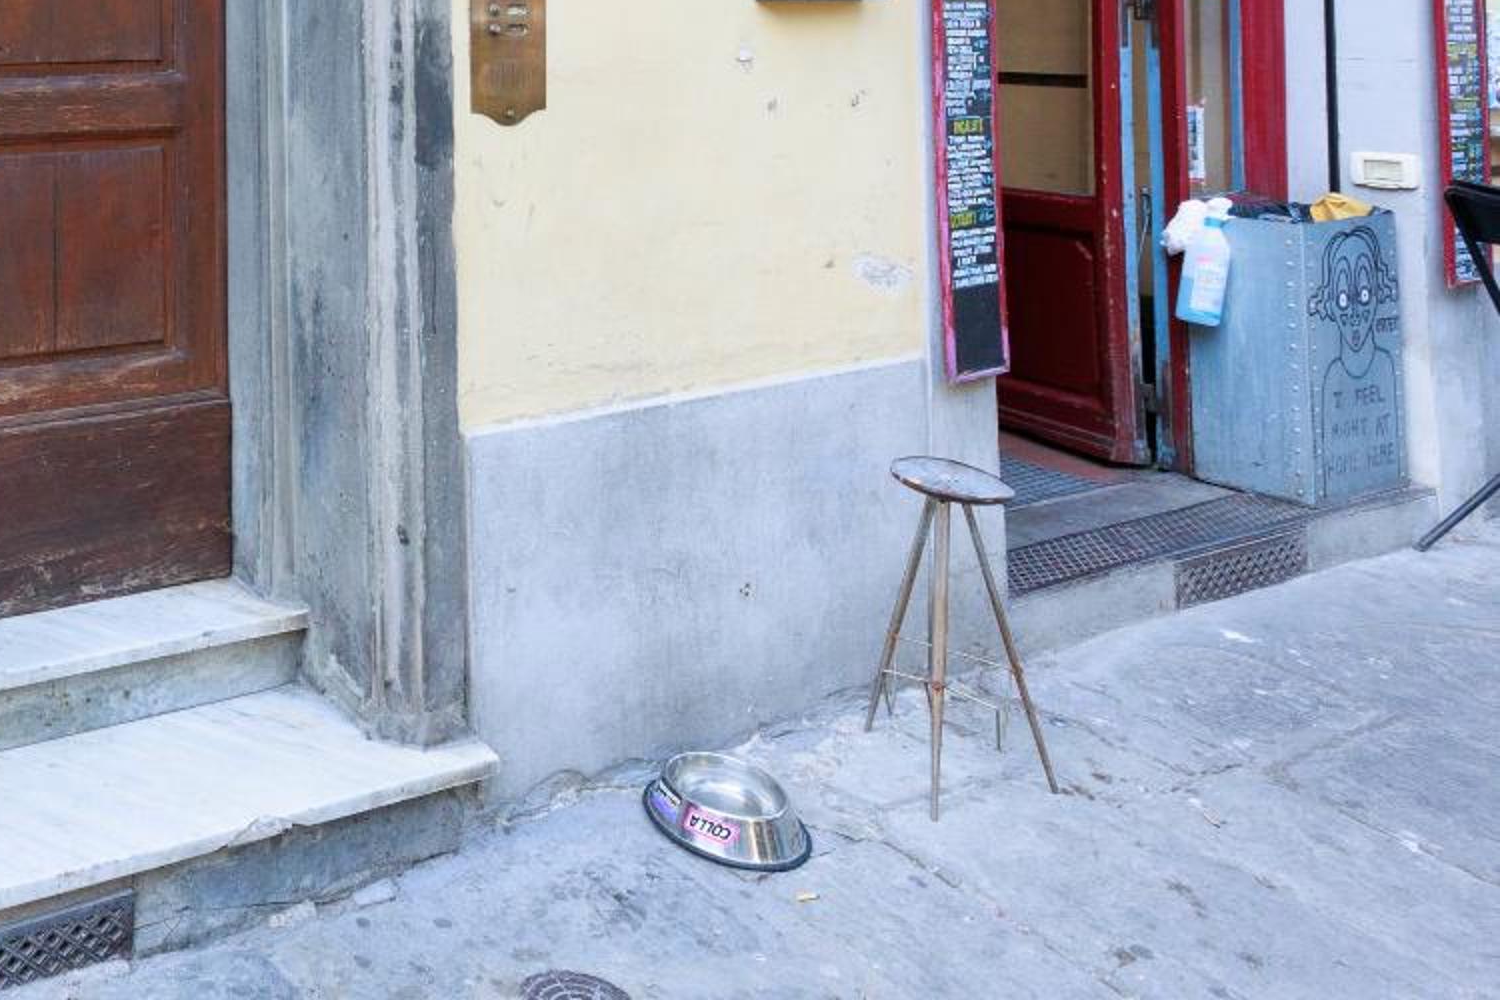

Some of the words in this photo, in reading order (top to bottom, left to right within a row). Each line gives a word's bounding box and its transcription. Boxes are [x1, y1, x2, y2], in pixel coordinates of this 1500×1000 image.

[1355, 384, 1386, 407] FEEL
[1375, 412, 1392, 439] AT
[689, 814, 732, 841] COLLA
